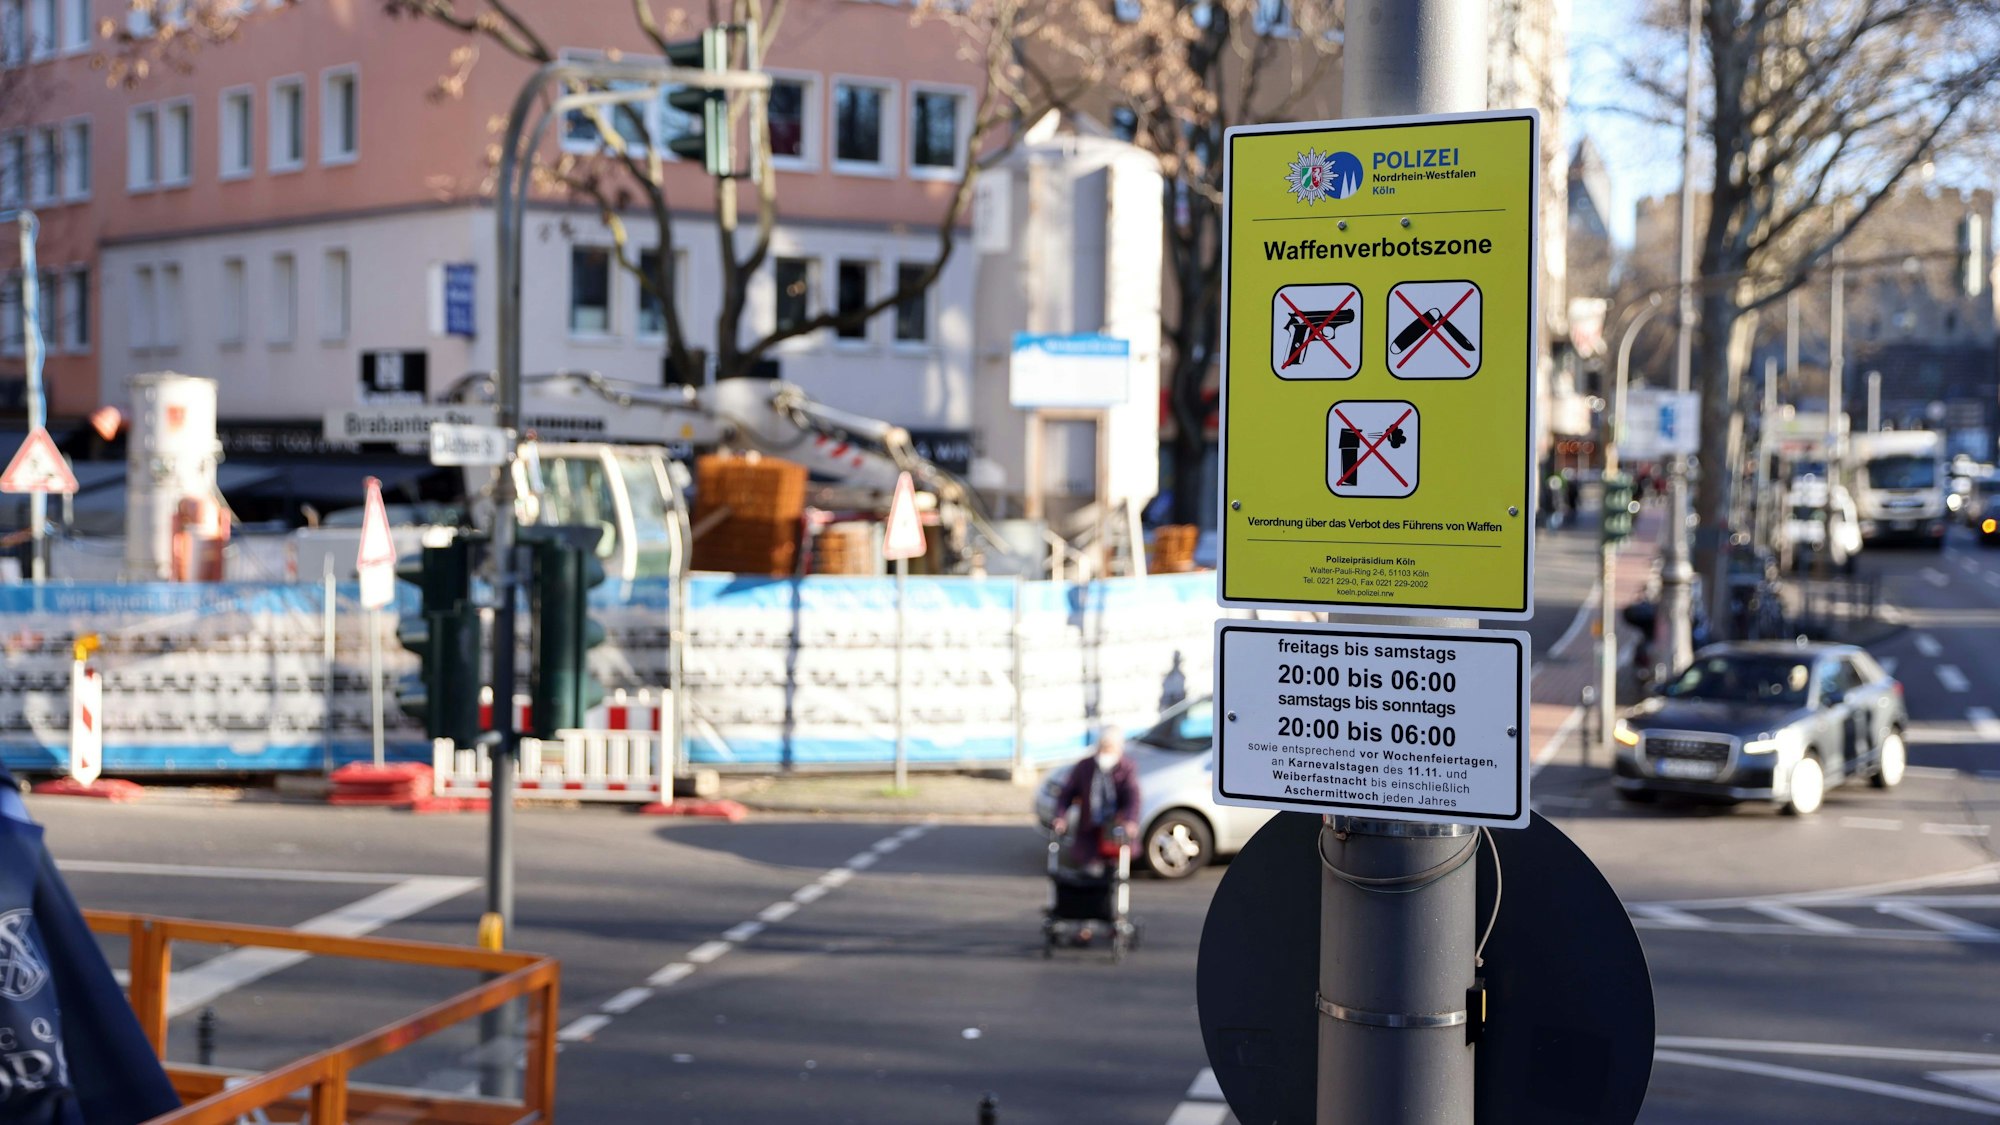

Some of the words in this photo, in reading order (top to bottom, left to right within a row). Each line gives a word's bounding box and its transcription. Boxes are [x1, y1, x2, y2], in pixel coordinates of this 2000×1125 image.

[1373, 148, 1458, 169] POLIZEI
[1373, 169, 1476, 182] Nordrhein-Westfalen
[1373, 186, 1395, 195] Köln
[1264, 236, 1492, 260] Waffenverbotszone
[1248, 516, 1302, 529] Verordnung
[1306, 518, 1327, 528] über
[1329, 518, 1346, 528] das
[1349, 519, 1381, 529] Verbot
[1383, 520, 1400, 529] des
[1403, 521, 1443, 530] Führens
[1467, 522, 1502, 531] Waffen
[1327, 556, 1393, 566] Polizeipräsidium
[1396, 557, 1415, 565] Köln
[1310, 567, 1370, 577] Walter-Pauli-Ring
[1389, 569, 1411, 577] 51103
[1335, 578, 1358, 586] 229-0,
[1337, 588, 1394, 597] koeln.polizei.nrw
[1278, 639, 1338, 657] freitags
[1345, 641, 1368, 656] bis
[1374, 645, 1456, 663] samstags
[1278, 664, 1339, 686] 20:00
[1349, 668, 1382, 689] bis
[1391, 670, 1456, 692] 06:00
[1278, 692, 1351, 711] samstags
[1355, 696, 1378, 711] bis
[1382, 699, 1455, 717] sonntags
[1278, 716, 1339, 739] 20:00
[1348, 721, 1382, 742] bis
[1391, 723, 1455, 746] 06:00
[1248, 742, 1278, 752] sowie
[1282, 745, 1355, 758] entsprechend
[1382, 751, 1497, 768] Wochenfeiertagen,
[1271, 758, 1284, 766] an
[1288, 758, 1379, 773] Karnevalstagen
[1383, 764, 1402, 774] des
[1408, 766, 1443, 778] 11.11.
[1446, 769, 1467, 779] und
[1273, 770, 1367, 786] Weiberfastnacht
[1371, 777, 1387, 787] bis
[1391, 778, 1470, 794] einschließlich
[1285, 785, 1379, 801] Aschermittwoch
[1382, 792, 1414, 804] jeden
[1418, 794, 1457, 807] Jahres
